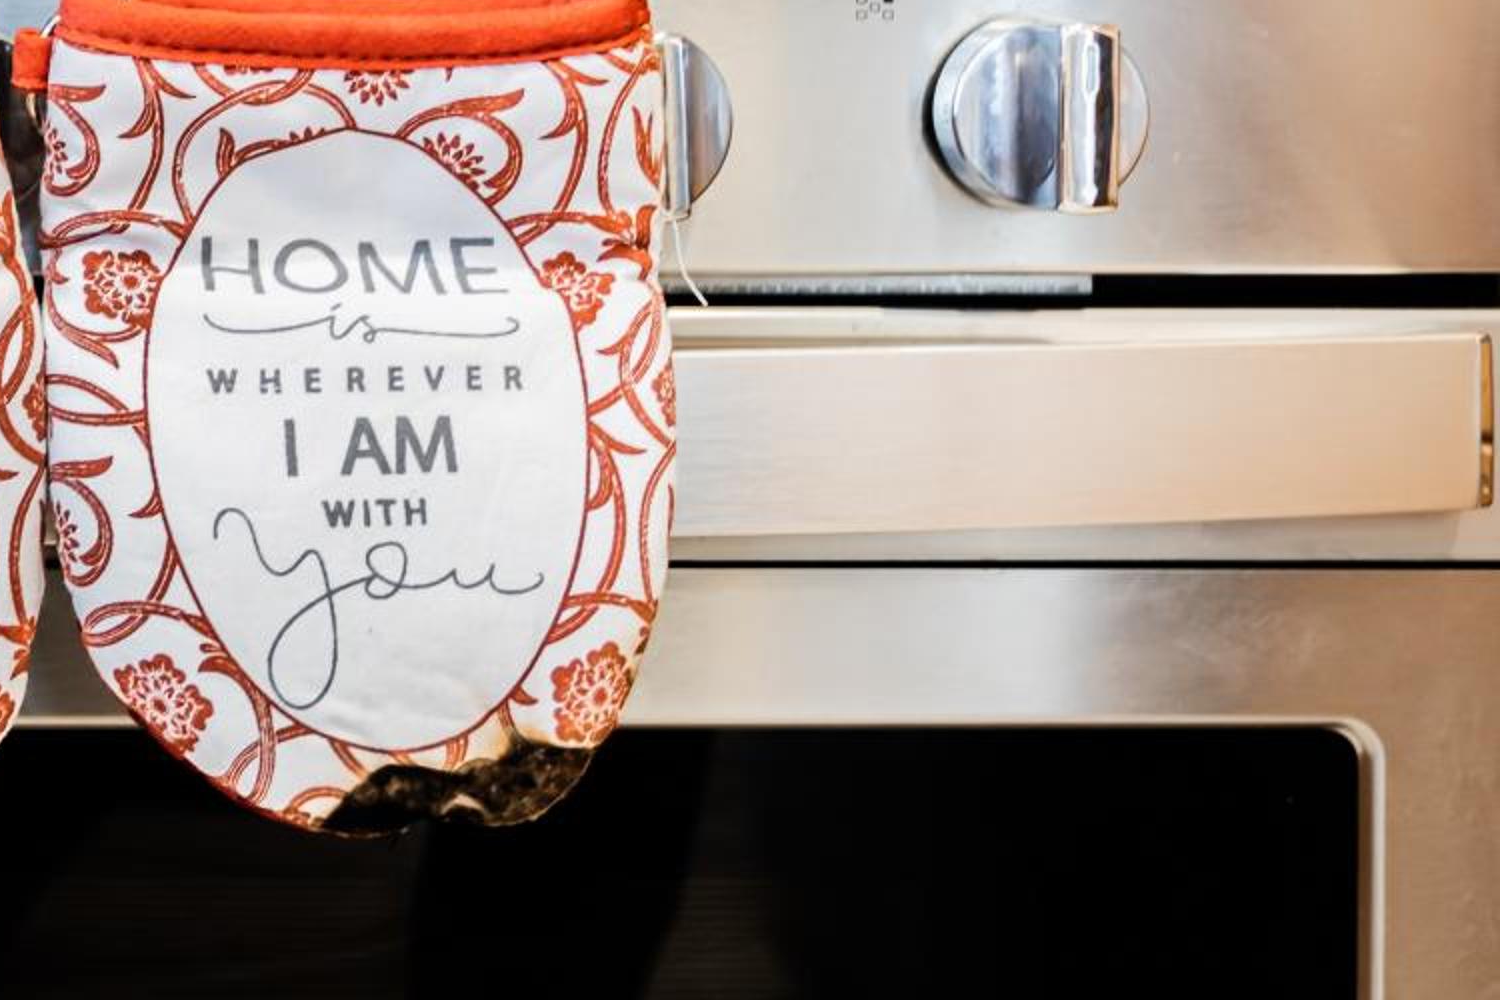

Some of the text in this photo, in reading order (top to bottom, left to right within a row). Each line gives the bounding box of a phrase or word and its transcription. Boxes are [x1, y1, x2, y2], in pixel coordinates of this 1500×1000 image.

[200, 236, 510, 295] HOME
[207, 365, 524, 395] WHEREVER
[283, 415, 459, 478] I AM
[322, 498, 428, 529] WITH
